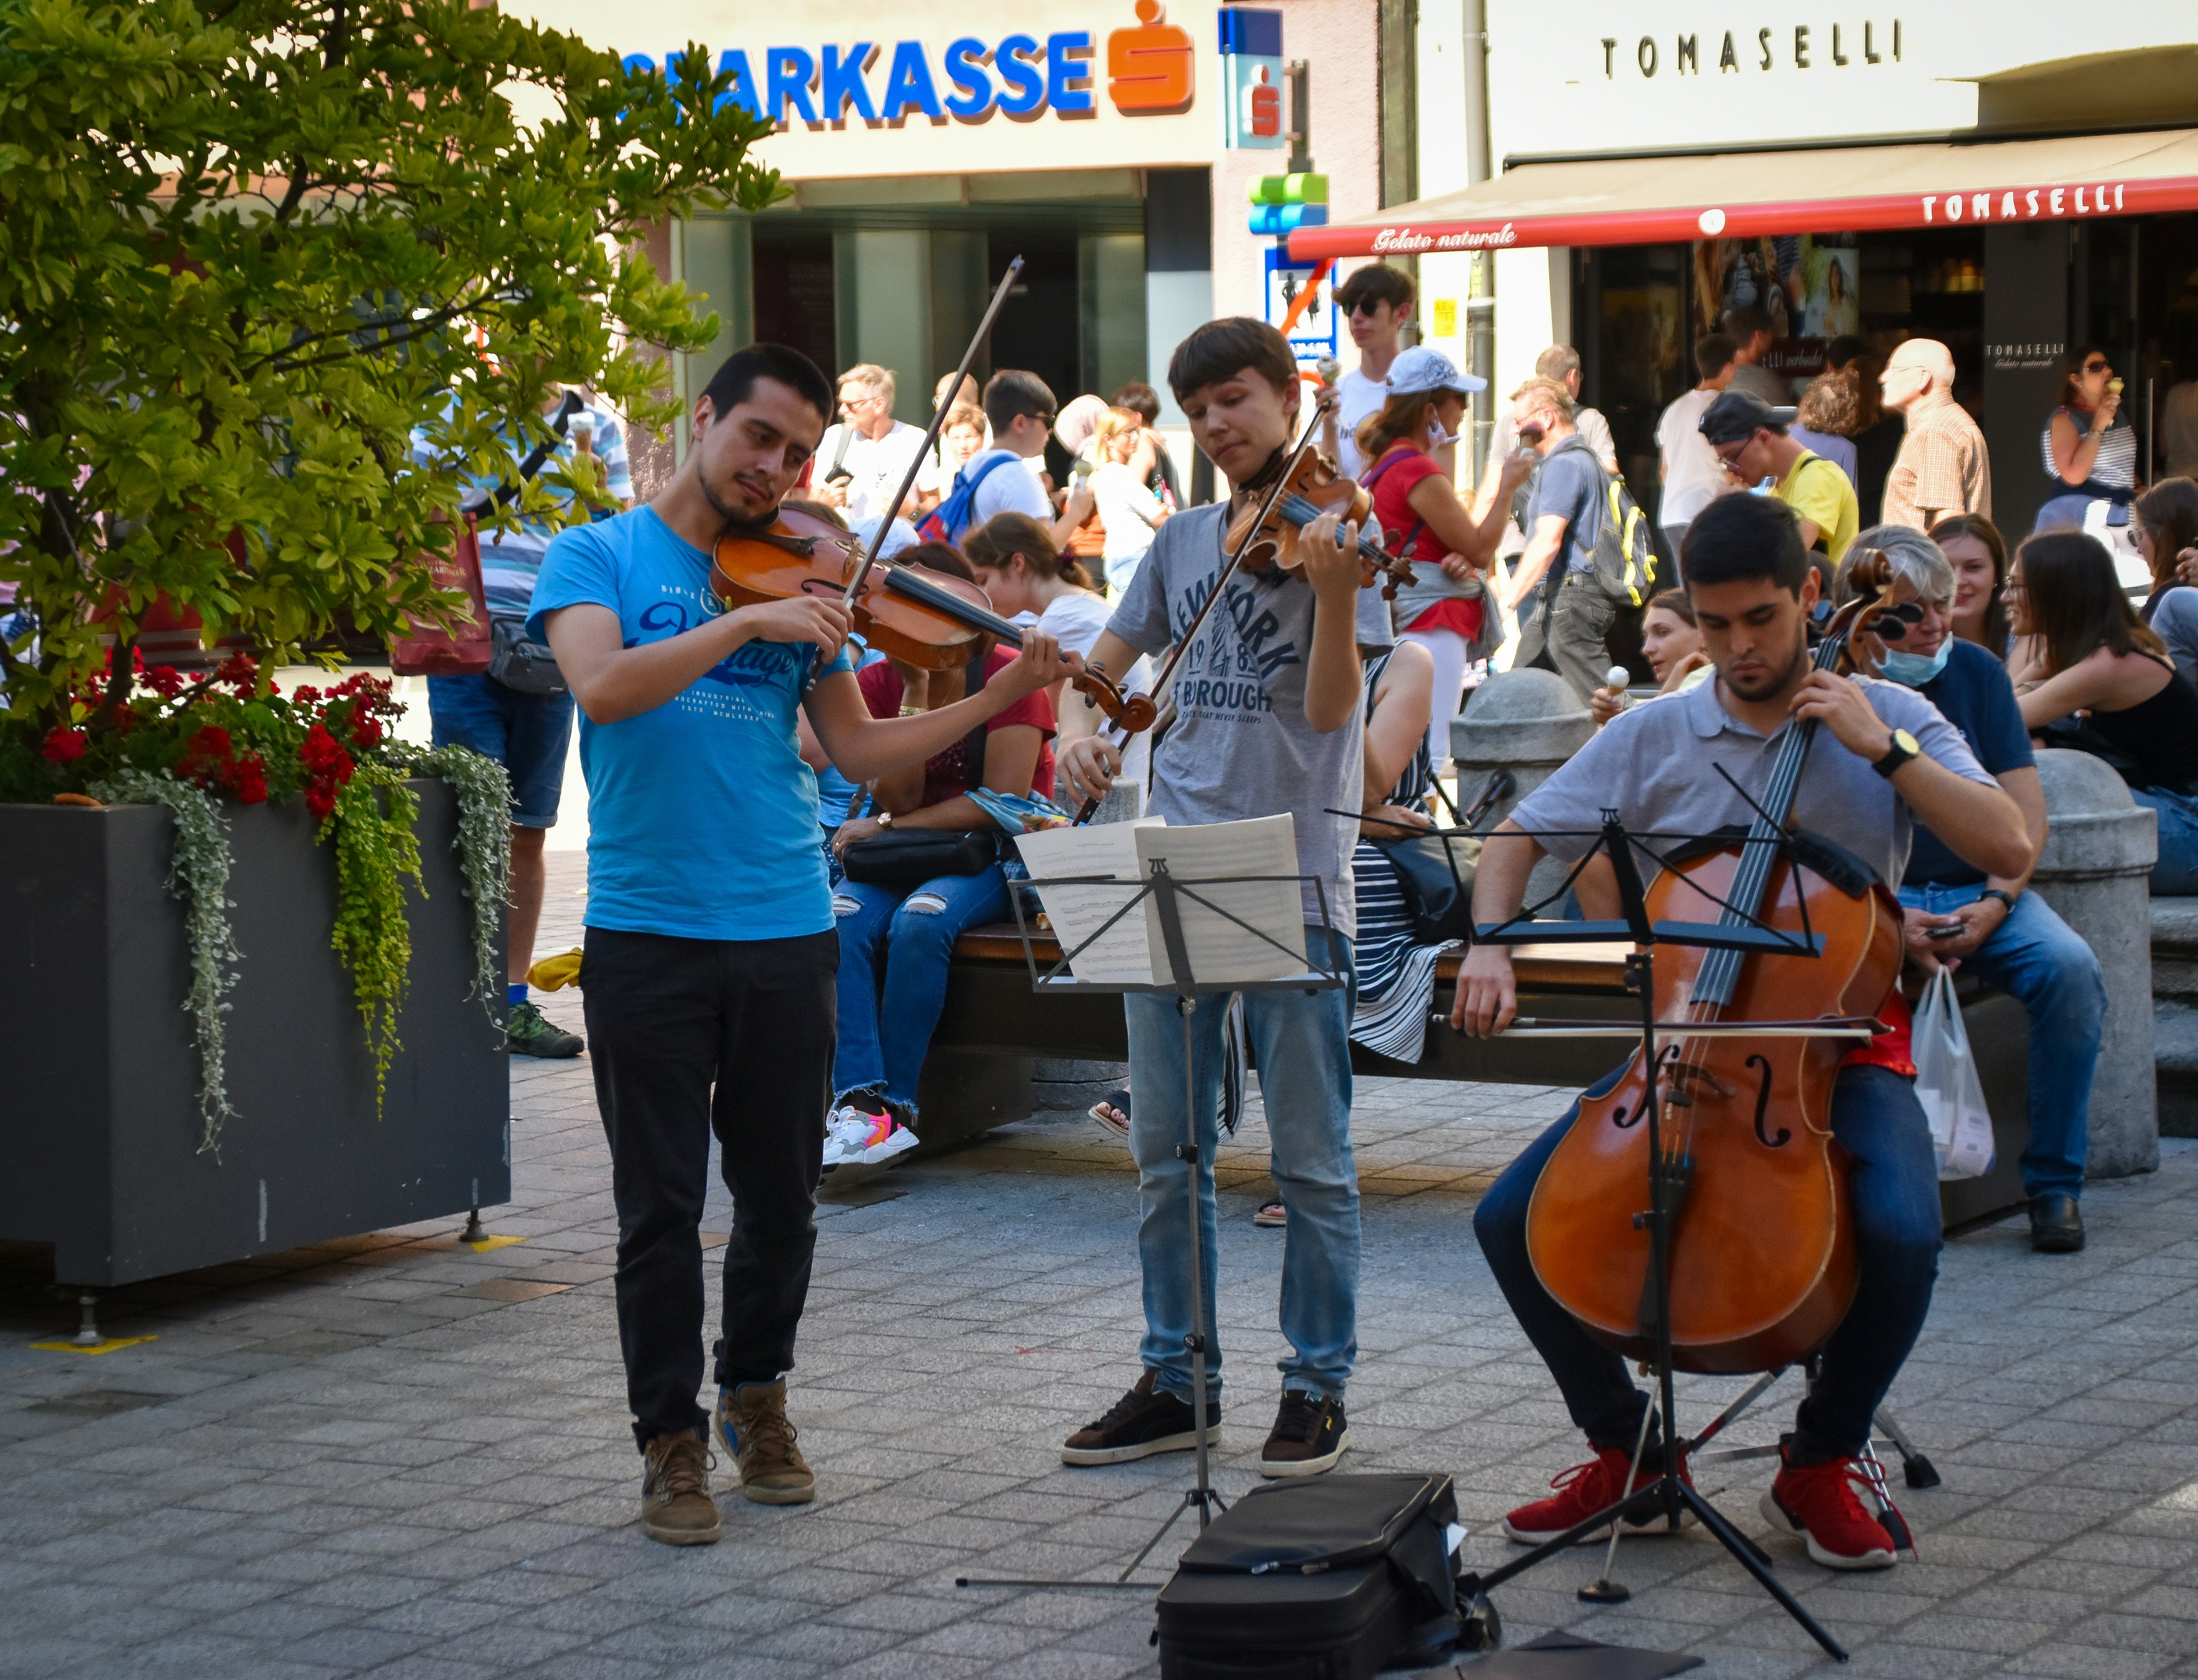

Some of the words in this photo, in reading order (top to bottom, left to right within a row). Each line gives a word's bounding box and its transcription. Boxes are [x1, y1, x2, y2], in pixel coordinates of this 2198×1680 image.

[1601, 18, 1902, 80] TOMASELLI
[1922, 184, 2124, 222] TOMASELLI
[1371, 228, 1435, 253] Gelato
[1435, 222, 1517, 250] naturale
[1987, 343, 2063, 355] TOMASELLI
[1996, 358, 2020, 367] Gelato
[2022, 357, 2054, 367] naturale
[1237, 643, 1257, 673] 8
[675, 695, 725, 709] NDCRAFTED
[692, 690, 745, 703] INDUSTRIAL
